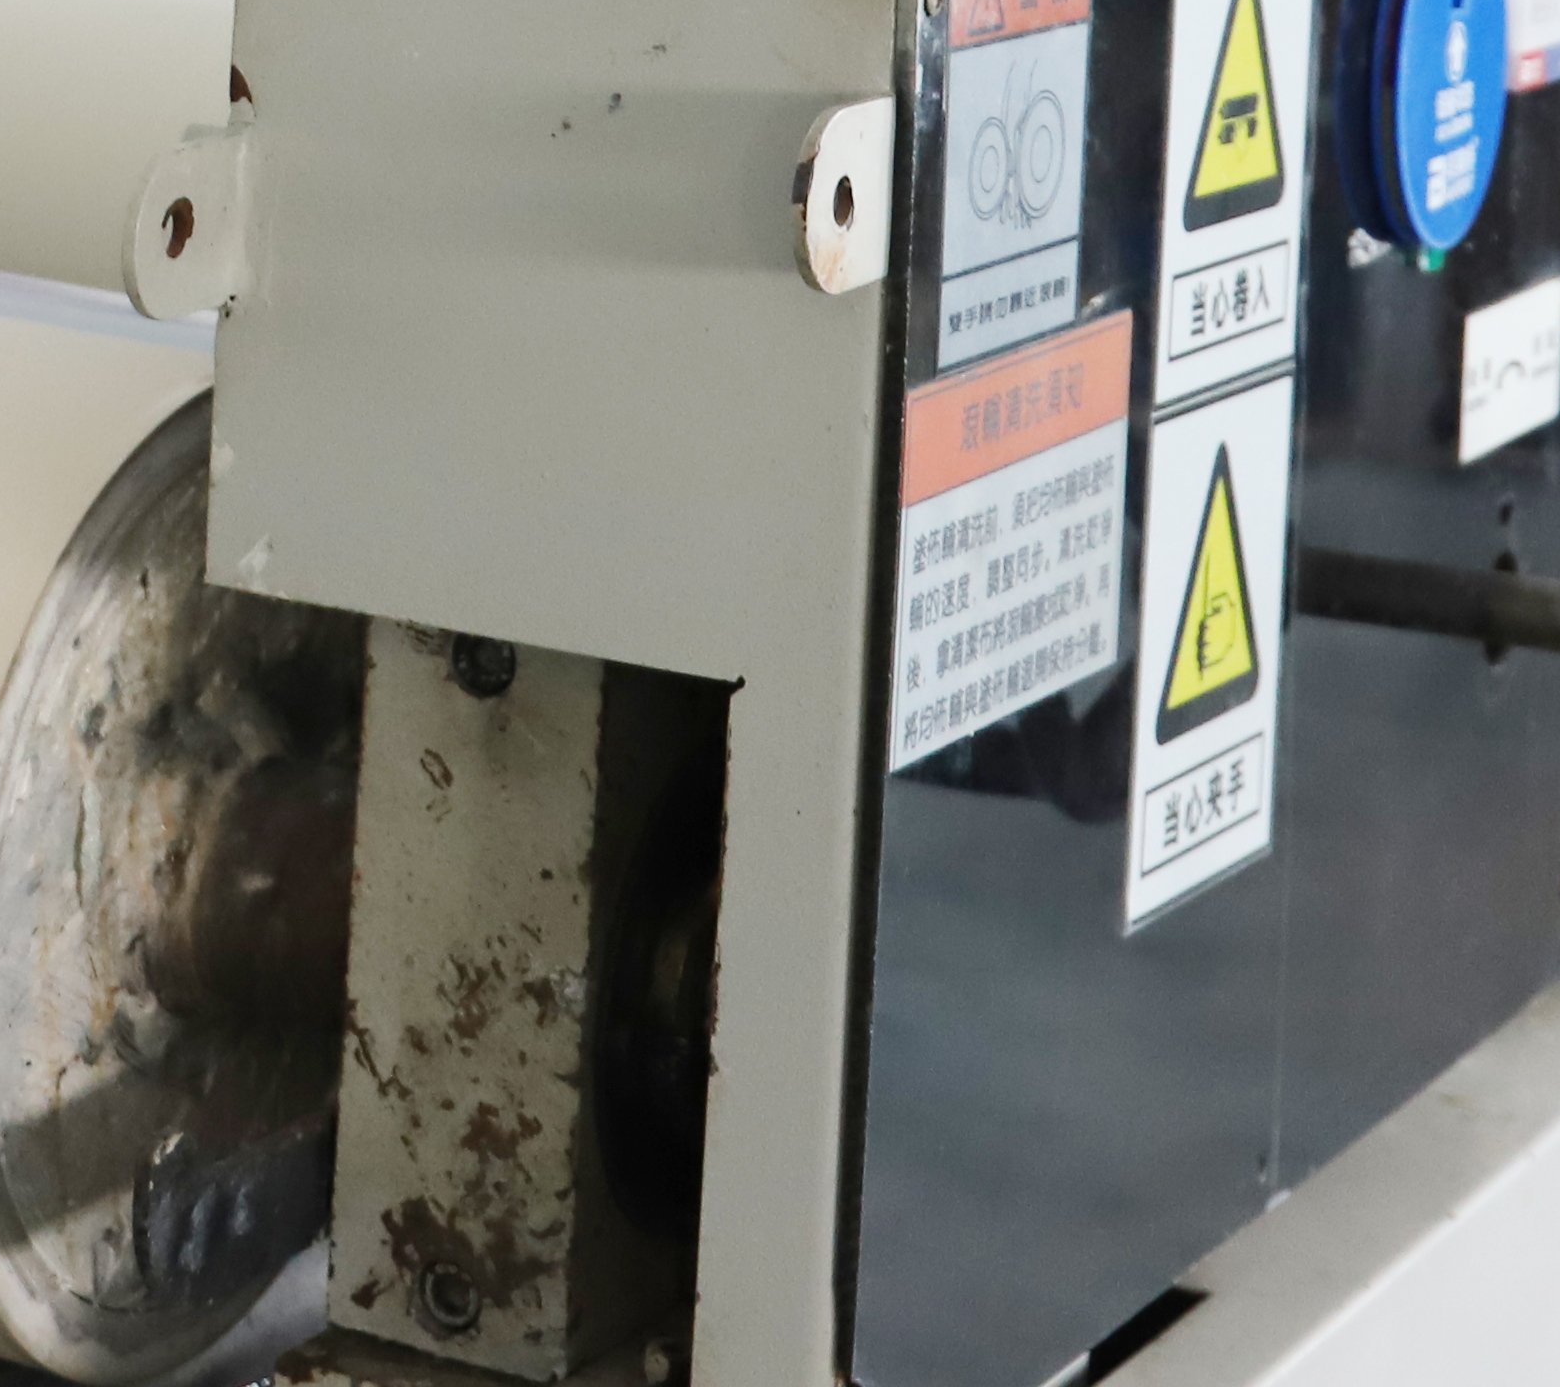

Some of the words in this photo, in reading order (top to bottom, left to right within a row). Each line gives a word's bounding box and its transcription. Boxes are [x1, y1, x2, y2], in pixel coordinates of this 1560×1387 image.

[1190, 265, 1269, 336] 当心卷入
[1164, 758, 1245, 847] 当心夹手
